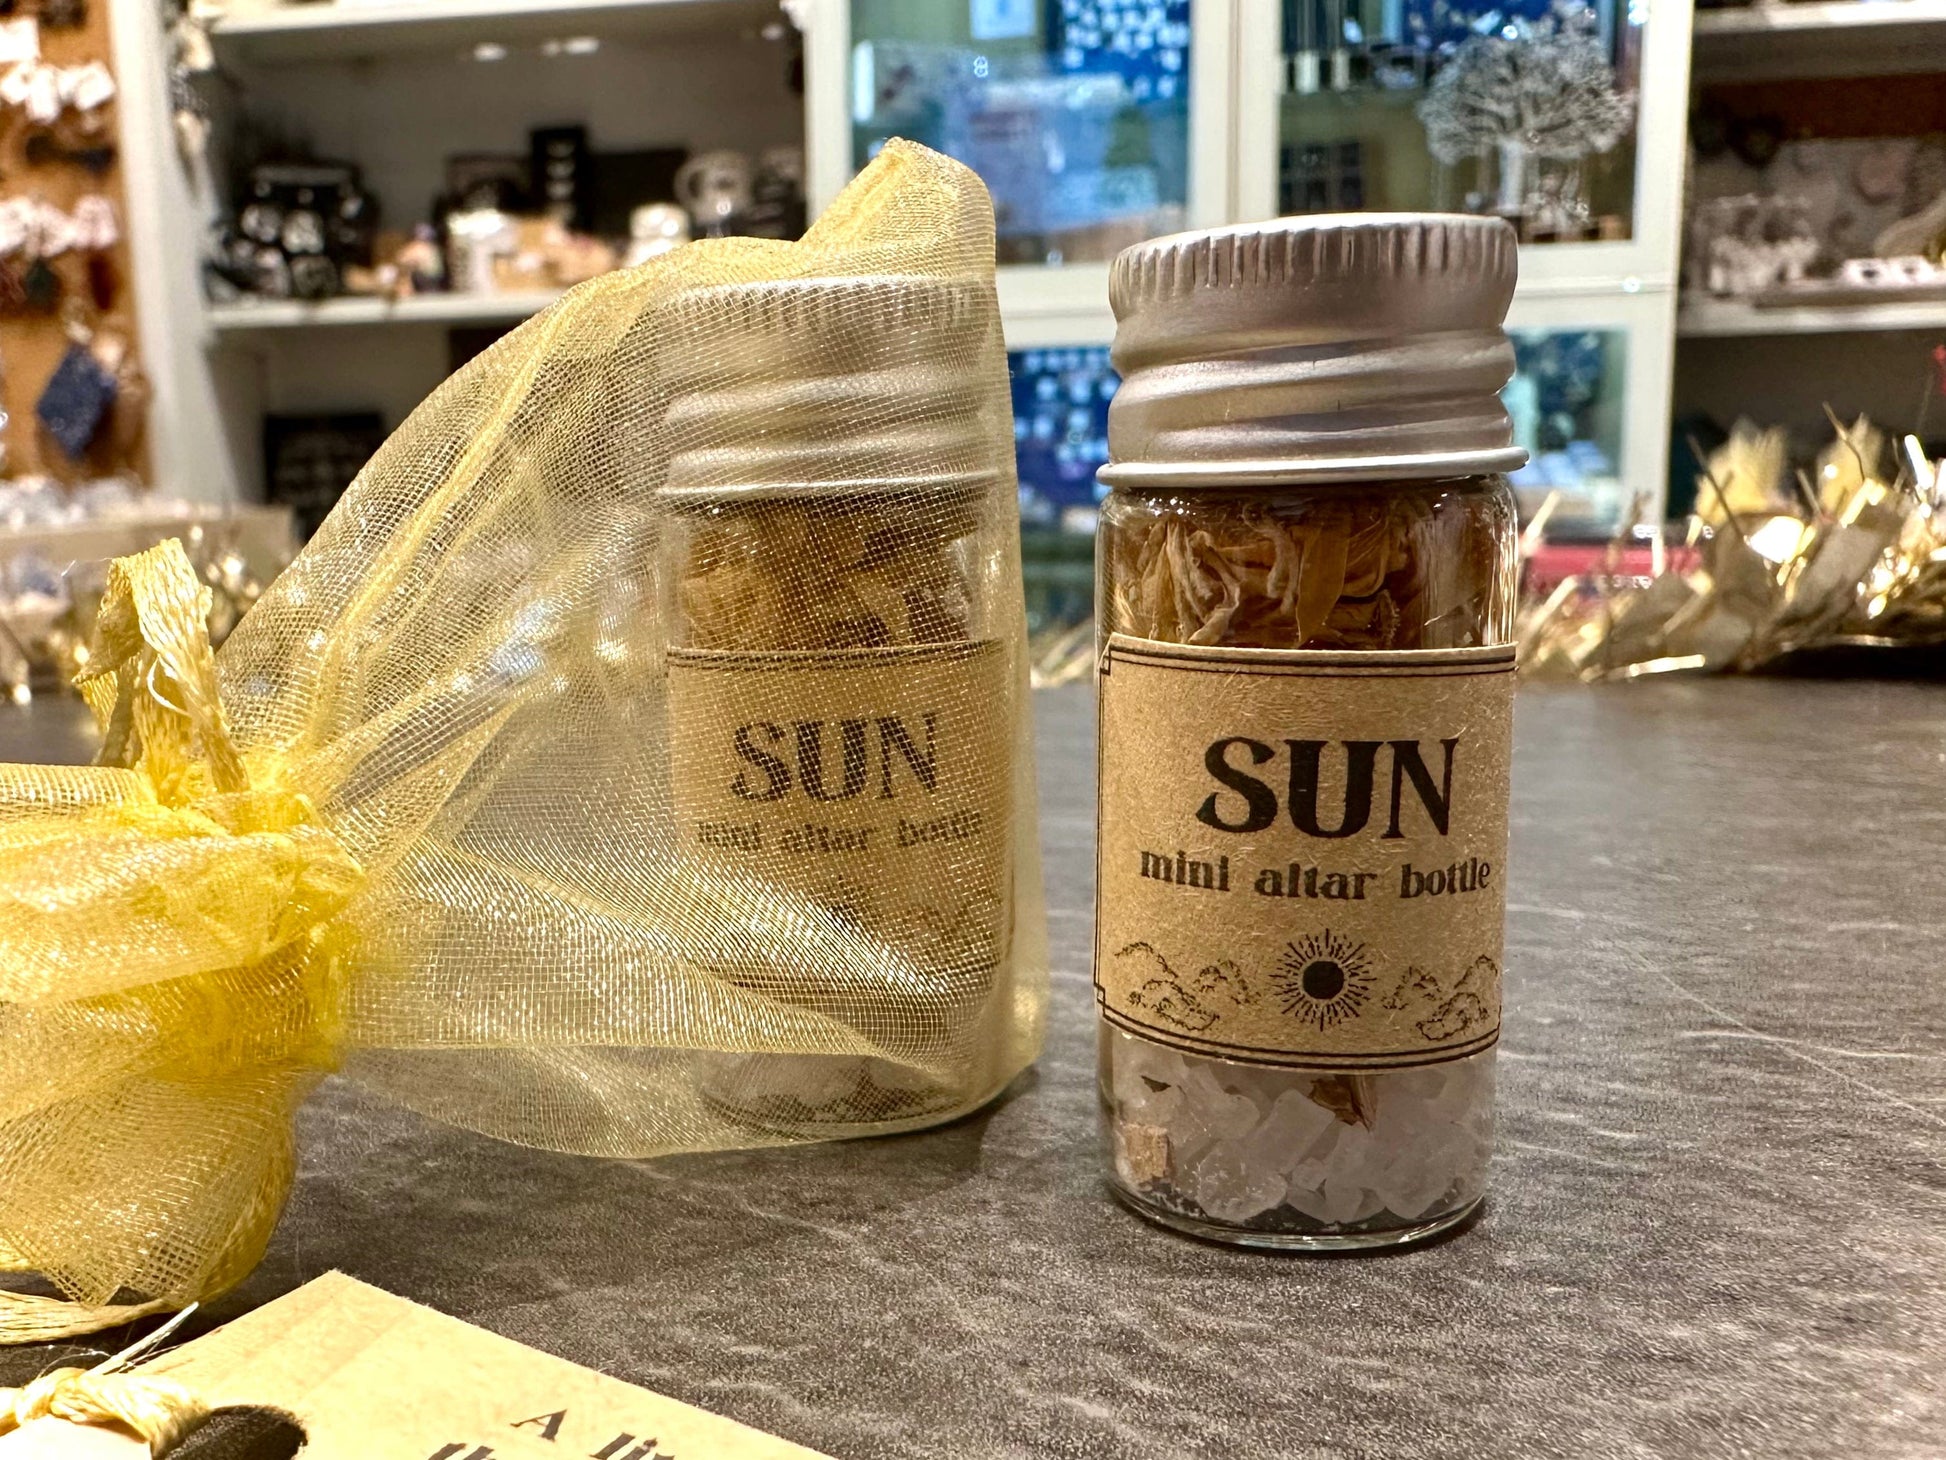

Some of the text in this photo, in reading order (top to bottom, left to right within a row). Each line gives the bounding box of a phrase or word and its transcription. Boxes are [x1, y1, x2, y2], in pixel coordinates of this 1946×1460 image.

[731, 711, 938, 802] SUN
[1195, 736, 1460, 839] SUN
[1140, 849, 1491, 900] mini altar bottle
[509, 1408, 568, 1442] A
